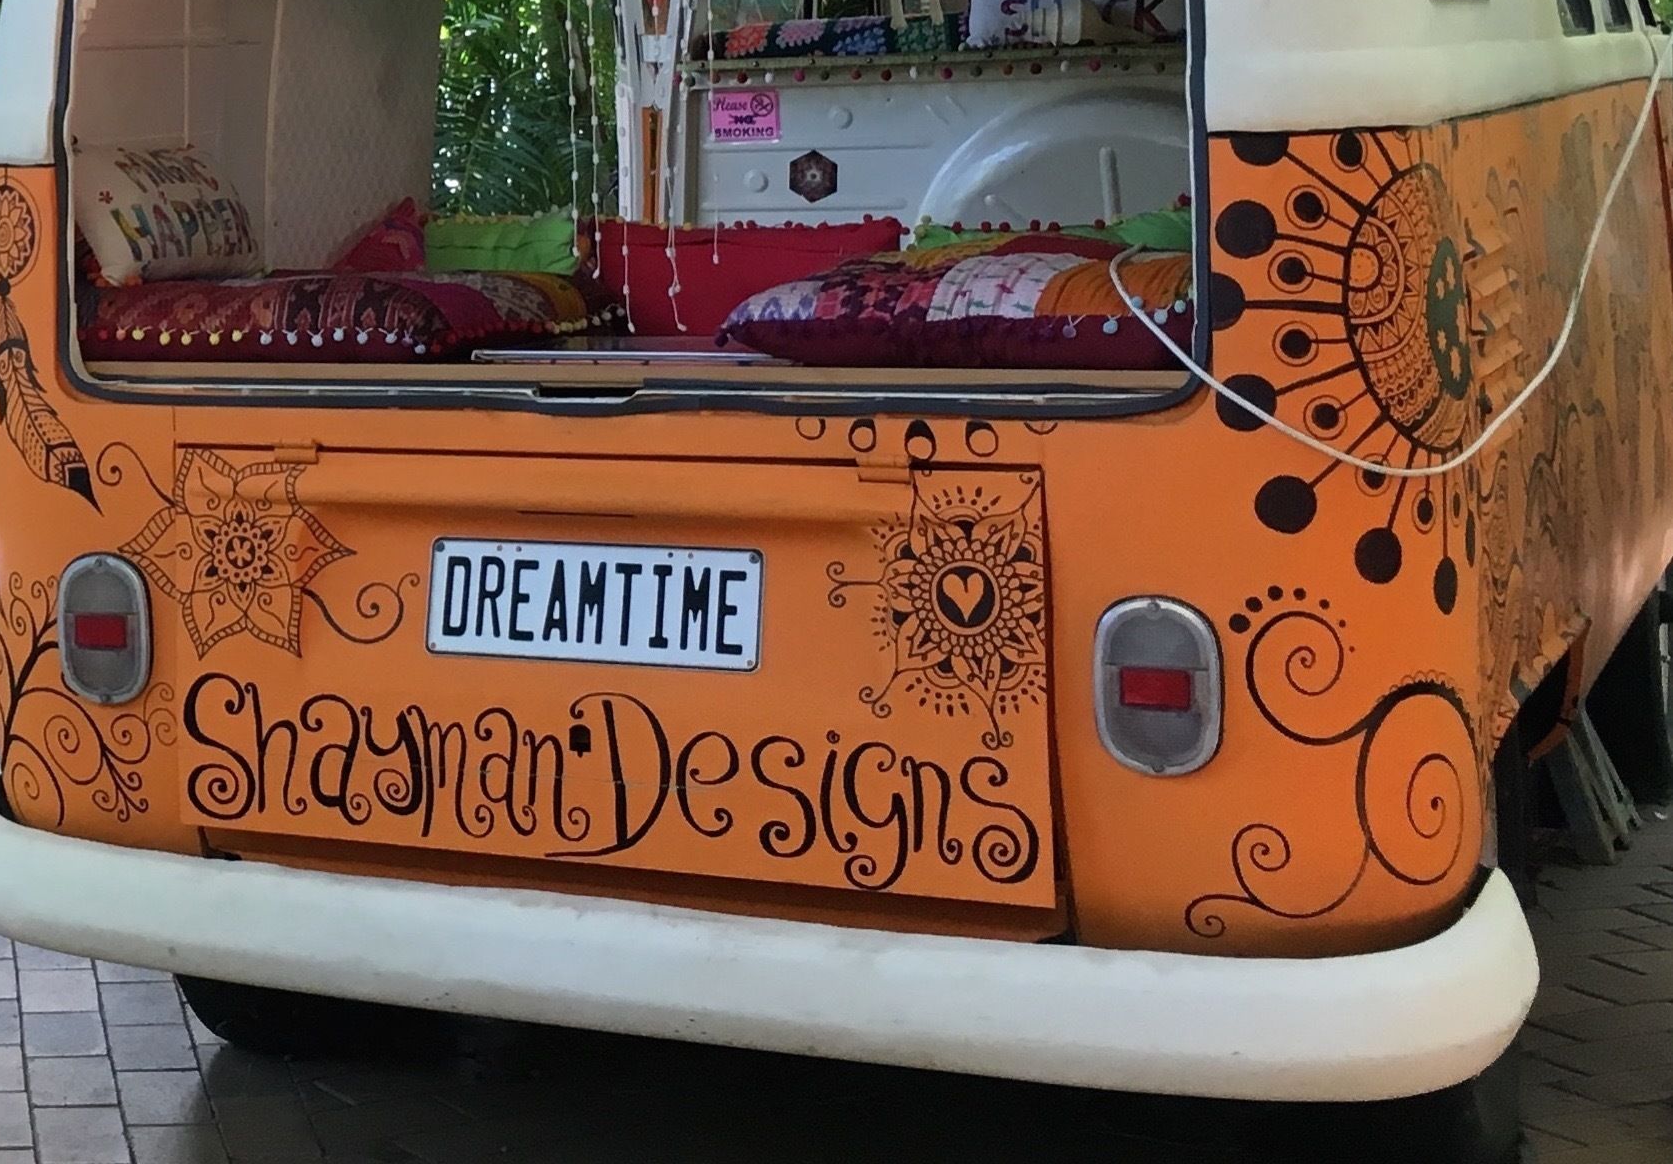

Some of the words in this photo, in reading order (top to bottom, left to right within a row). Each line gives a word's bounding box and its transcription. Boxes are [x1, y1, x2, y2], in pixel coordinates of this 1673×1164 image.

[712, 96, 747, 112] Please
[714, 127, 774, 138] SMOKING
[442, 555, 748, 656] DREAMTIME
[182, 671, 591, 842] Shayman
[544, 691, 1040, 890] Designs
